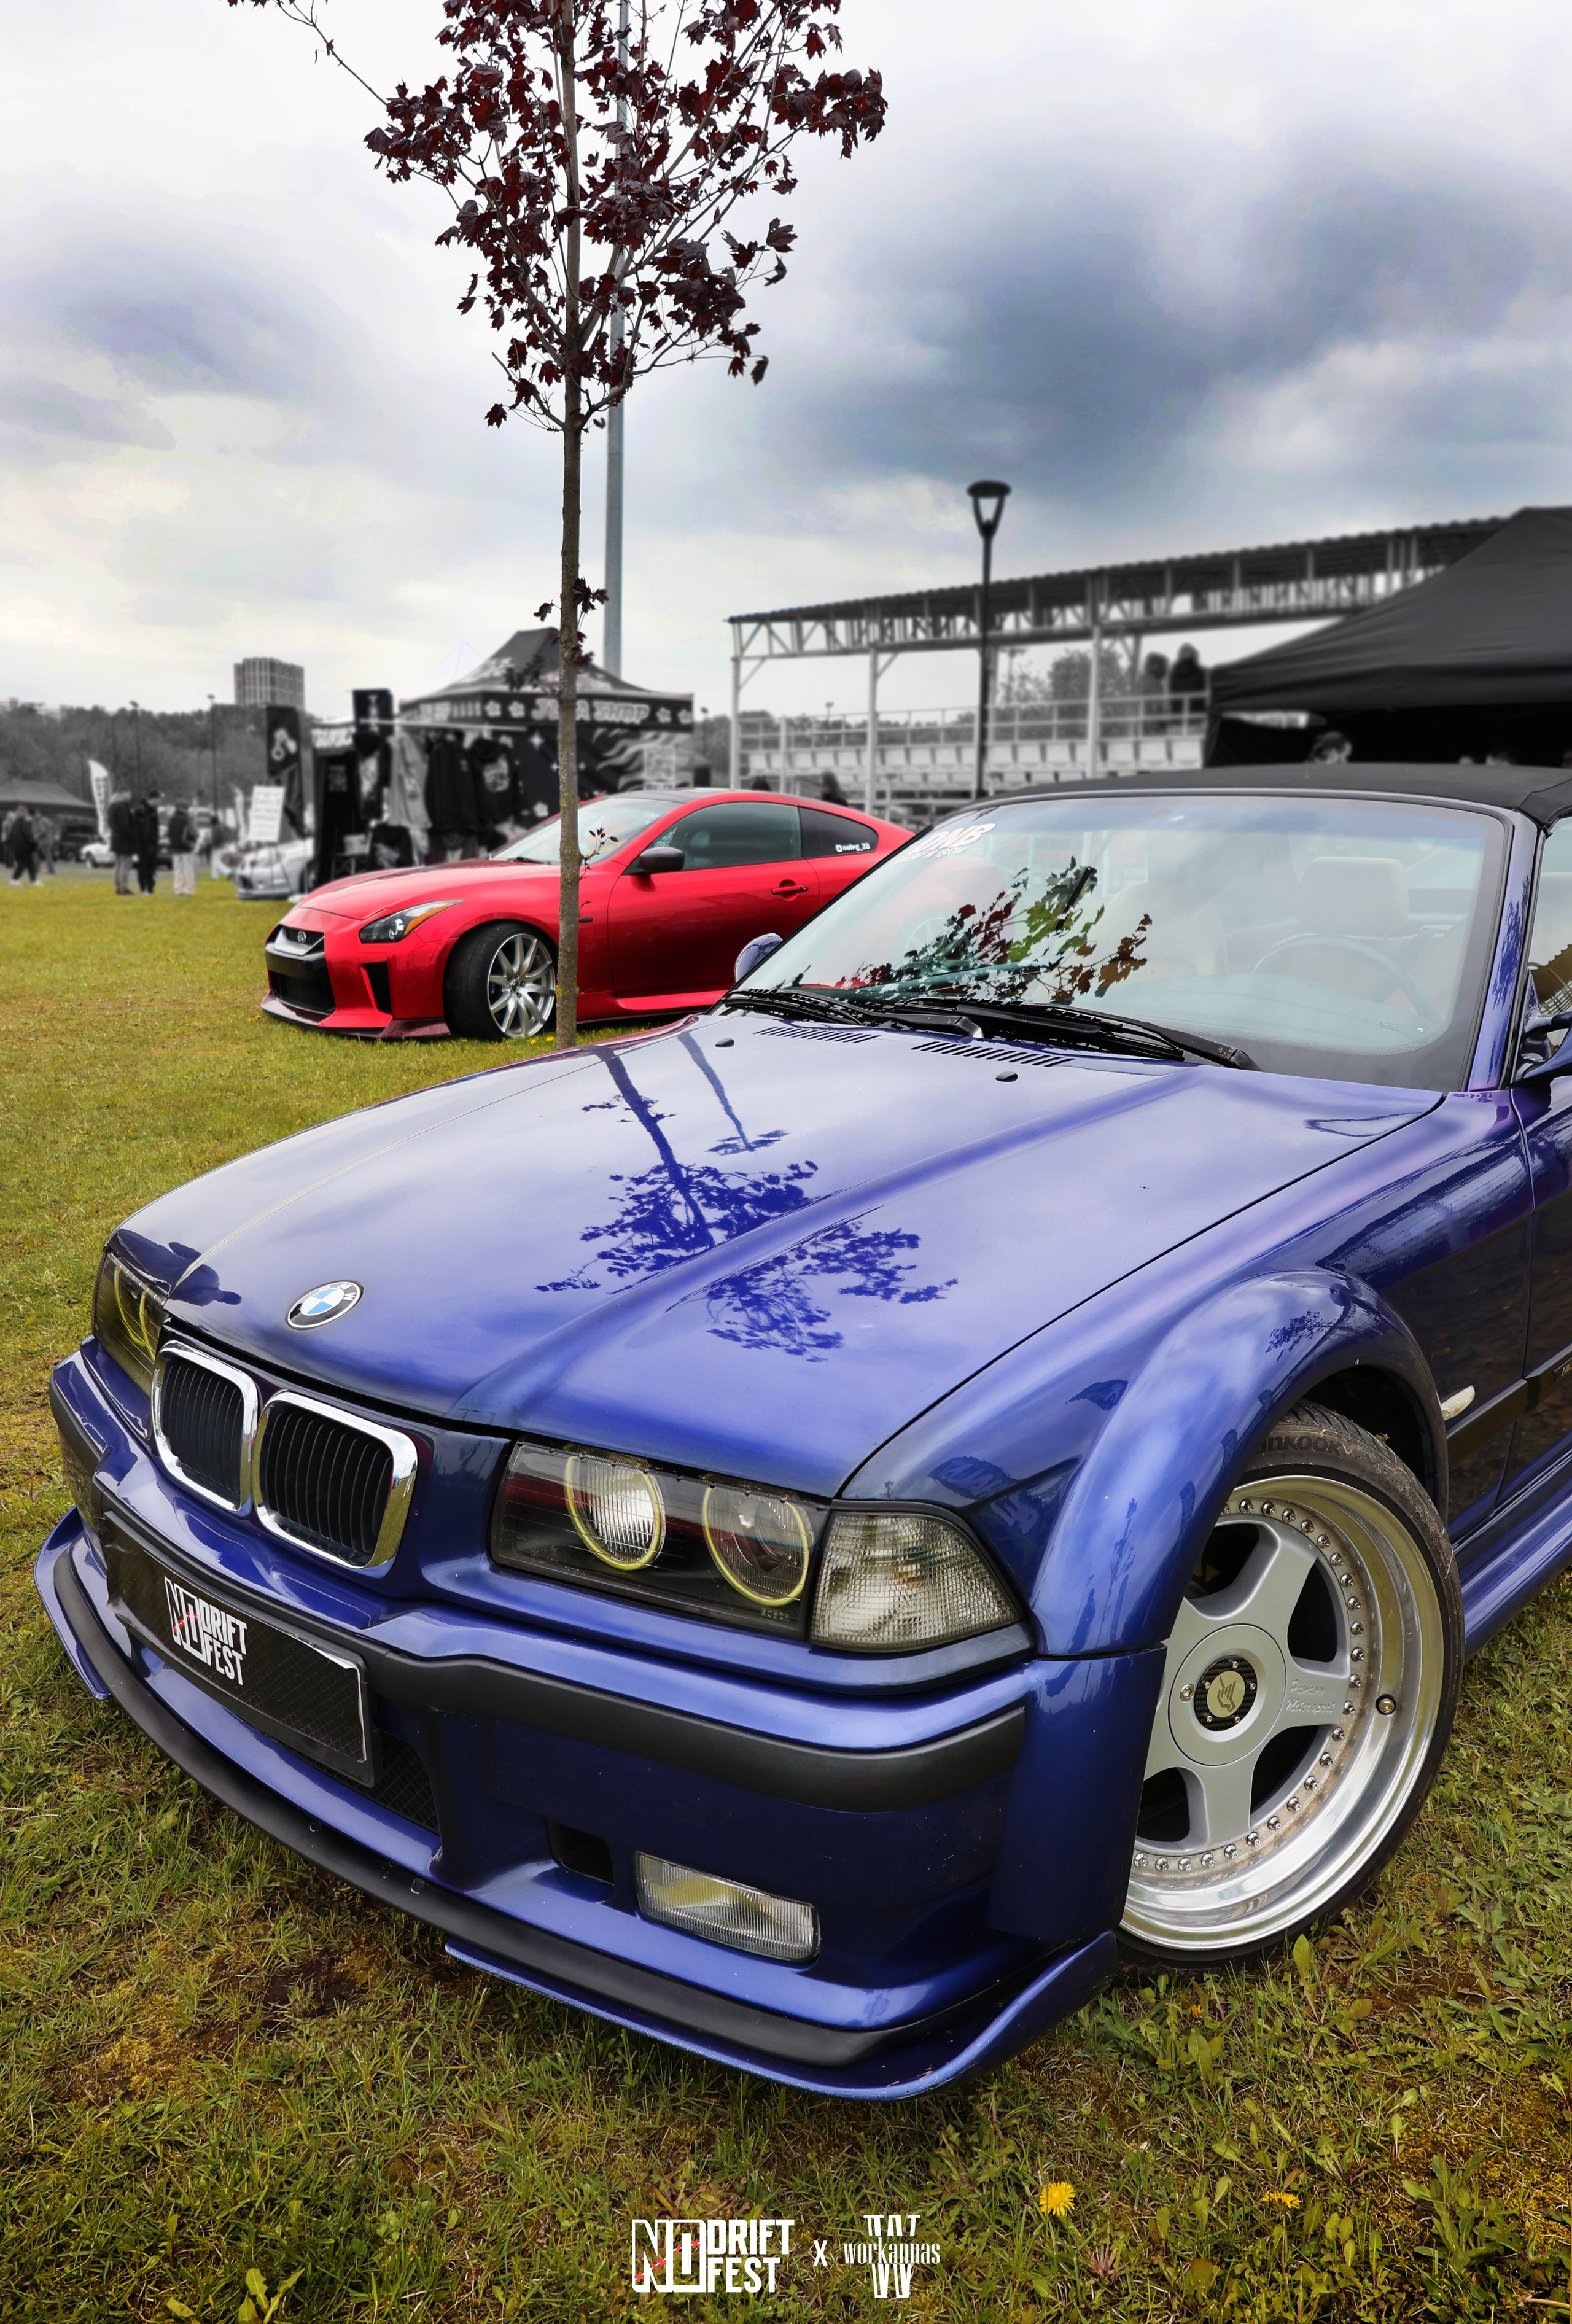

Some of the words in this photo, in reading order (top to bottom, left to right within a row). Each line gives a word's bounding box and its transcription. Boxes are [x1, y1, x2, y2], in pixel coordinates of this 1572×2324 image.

[907, 823, 996, 856] DNB
[198, 1598, 247, 1655] DRIFT
[203, 1632, 243, 1685] FEST
